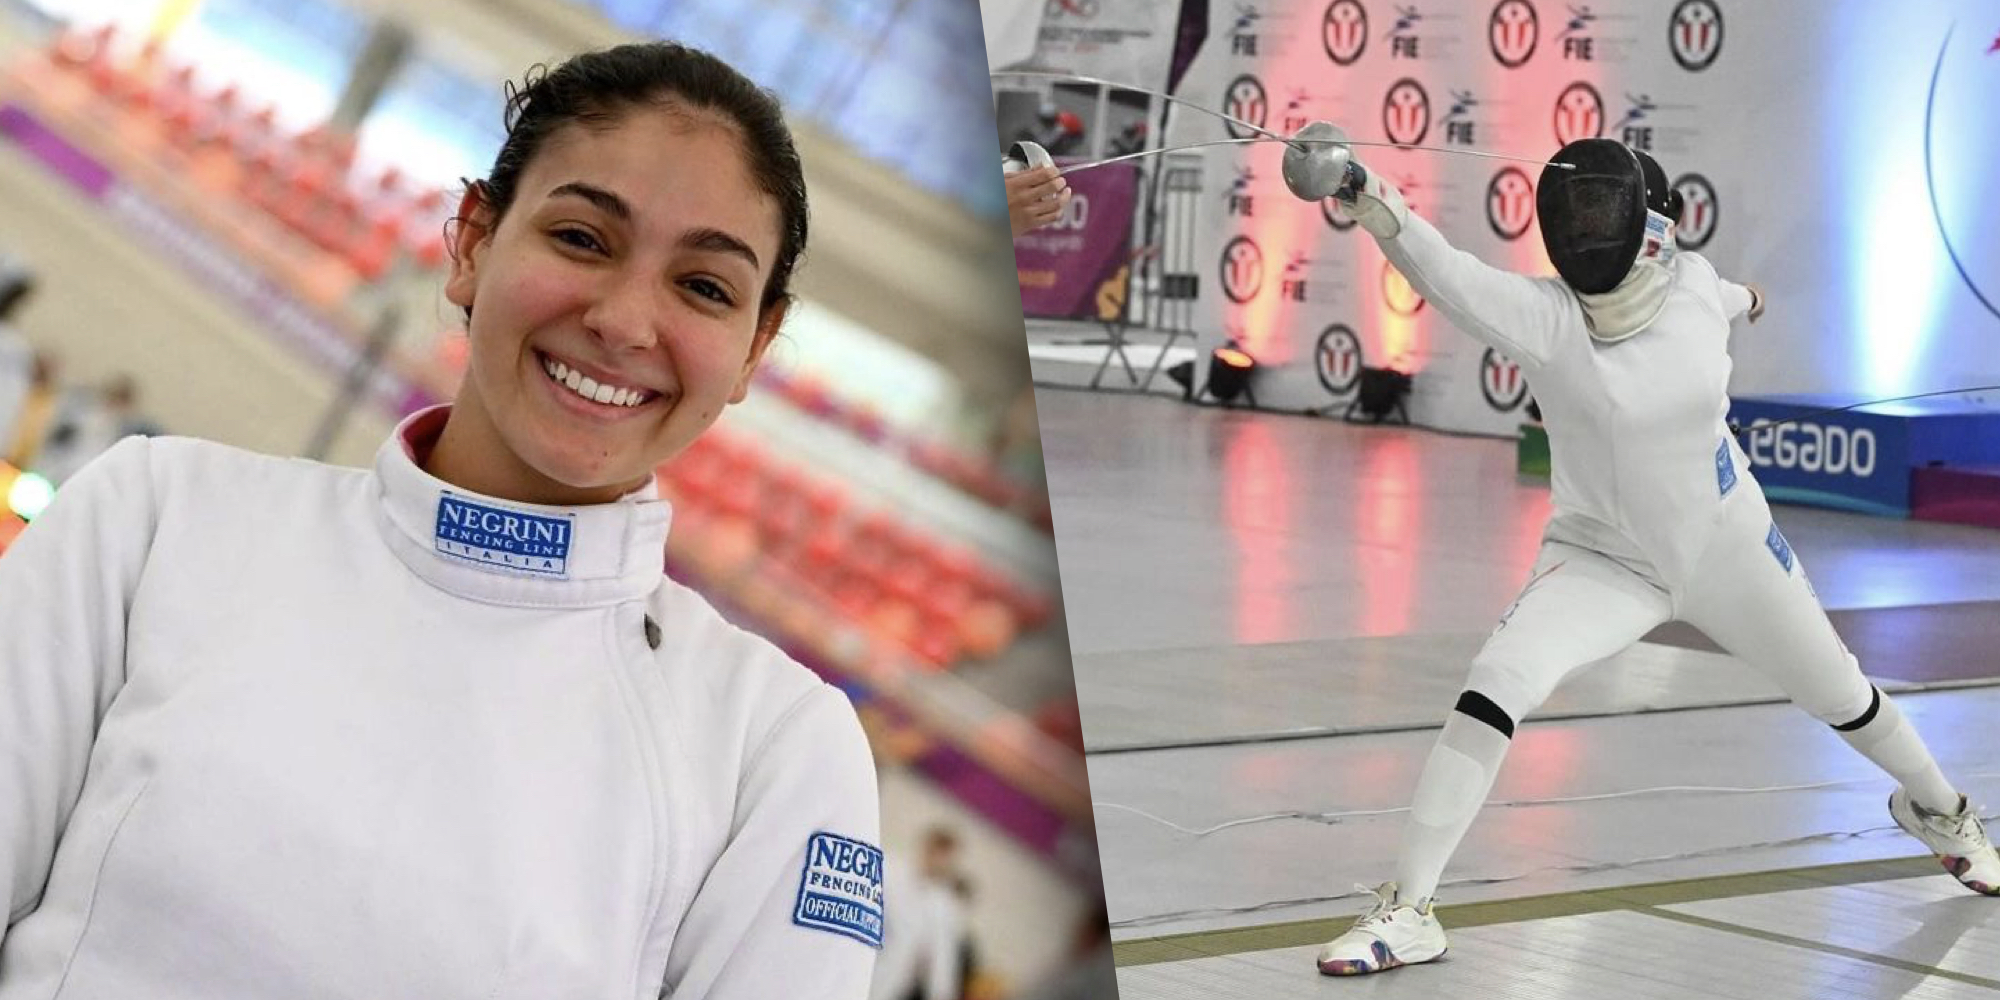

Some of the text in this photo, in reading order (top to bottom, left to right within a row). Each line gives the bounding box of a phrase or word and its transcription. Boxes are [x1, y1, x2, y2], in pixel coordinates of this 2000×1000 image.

[1392, 35, 1420, 59] FIE
[1564, 37, 1594, 61] FIE
[1447, 121, 1475, 145] FIE
[1623, 126, 1654, 150] FIE
[440, 502, 567, 545] NEGRINI
[438, 525, 565, 556] FENCING LINE
[446, 541, 553, 569] ITALIA
[805, 897, 860, 923] OFFICIAL
